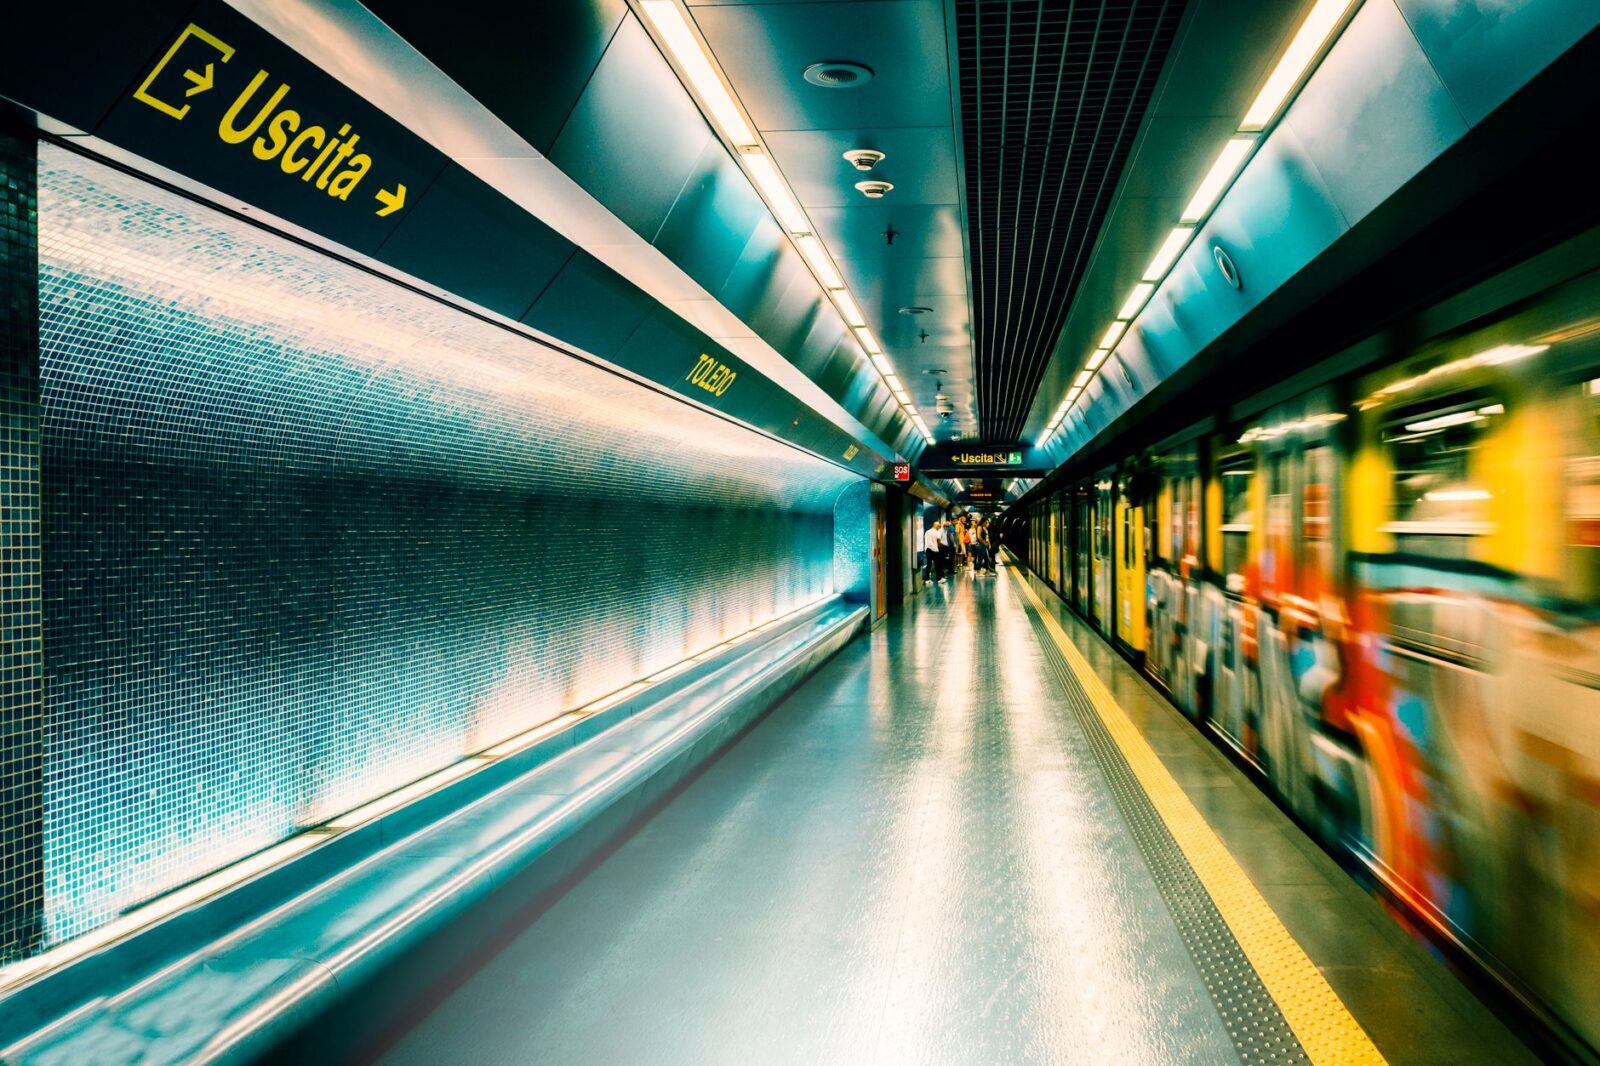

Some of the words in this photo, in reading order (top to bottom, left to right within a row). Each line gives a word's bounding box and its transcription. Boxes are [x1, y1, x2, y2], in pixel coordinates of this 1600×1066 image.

[218, 69, 372, 201] Uscita
[685, 353, 737, 397] TOLEDO
[894, 466, 908, 474] SOS
[961, 453, 993, 463] Uscita
